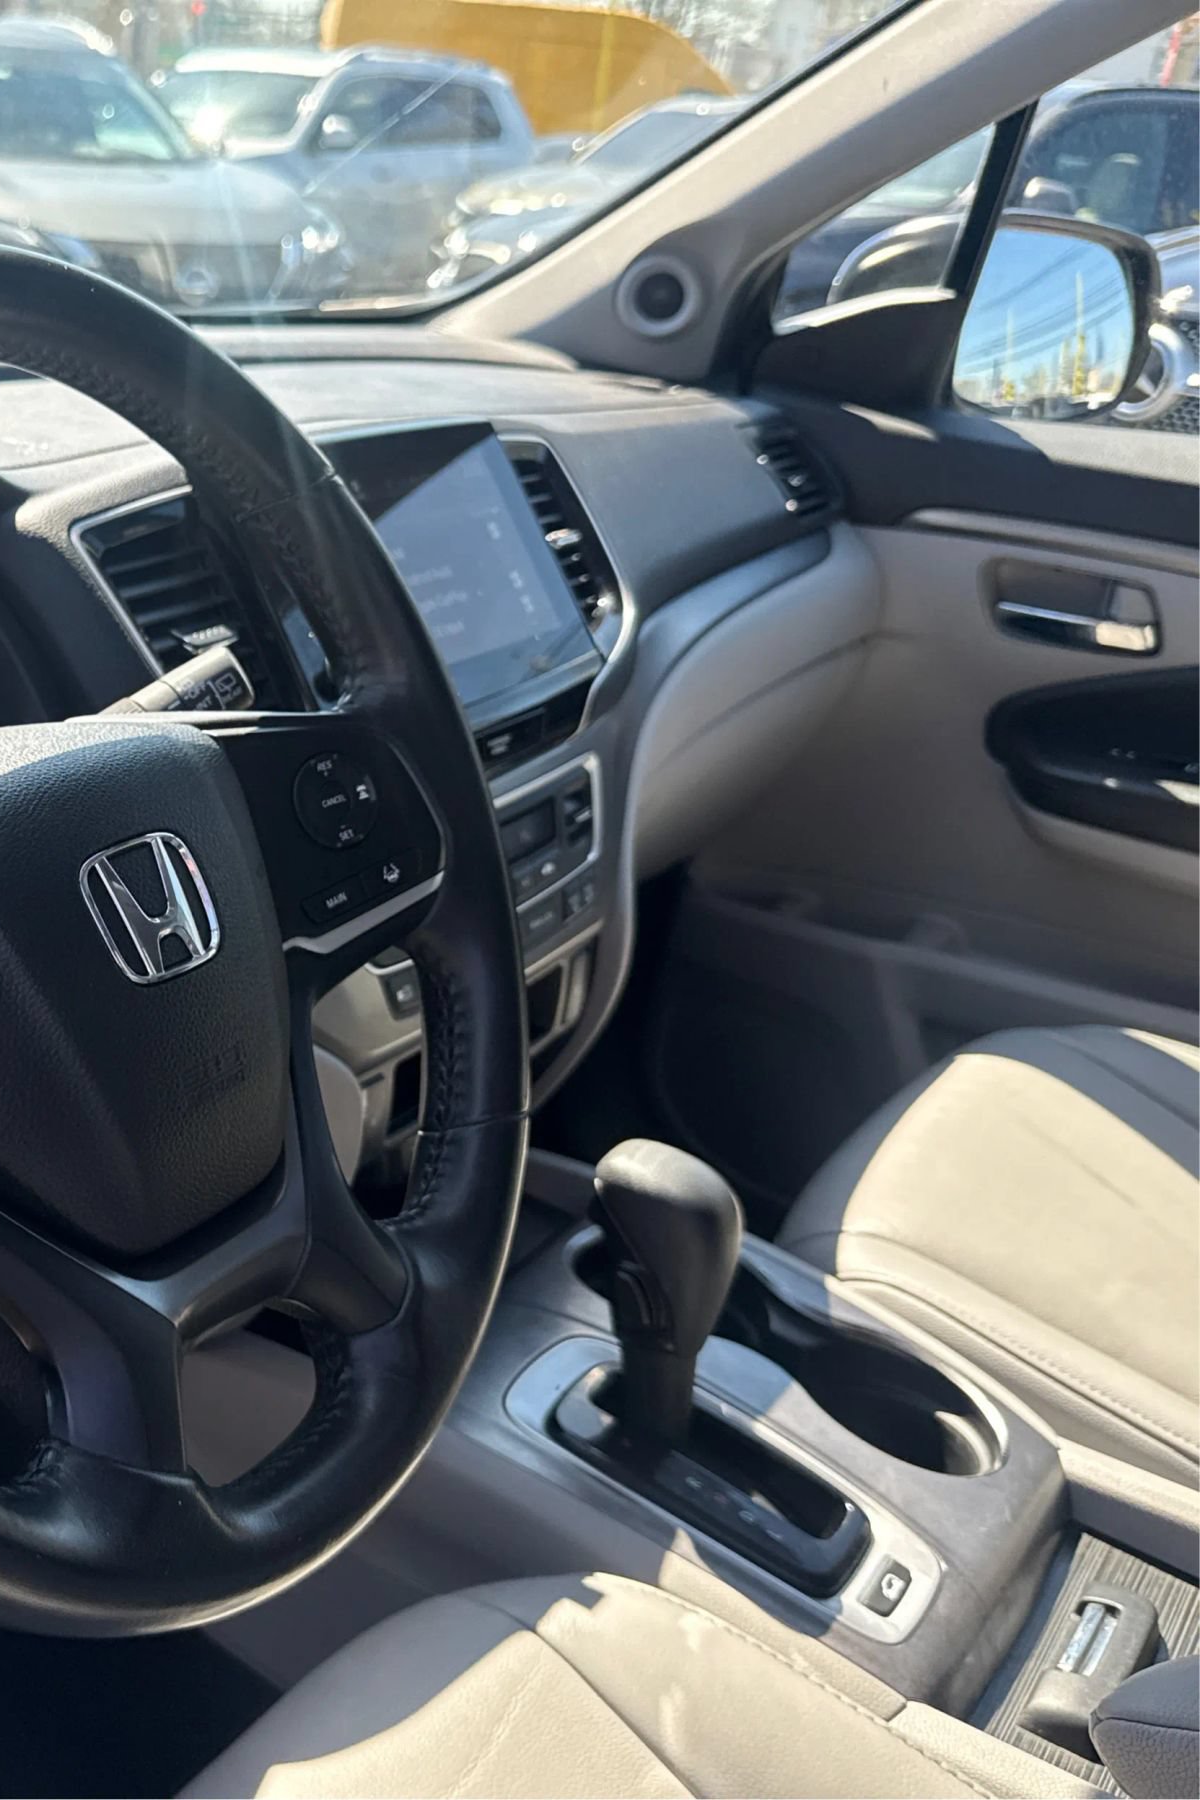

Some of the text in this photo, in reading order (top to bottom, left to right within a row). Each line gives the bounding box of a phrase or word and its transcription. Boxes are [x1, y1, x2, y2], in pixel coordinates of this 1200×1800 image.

[316, 759, 333, 773] RES
[321, 793, 347, 809] CANCEL
[338, 828, 355, 842] SET
[325, 891, 349, 909] MAIN
